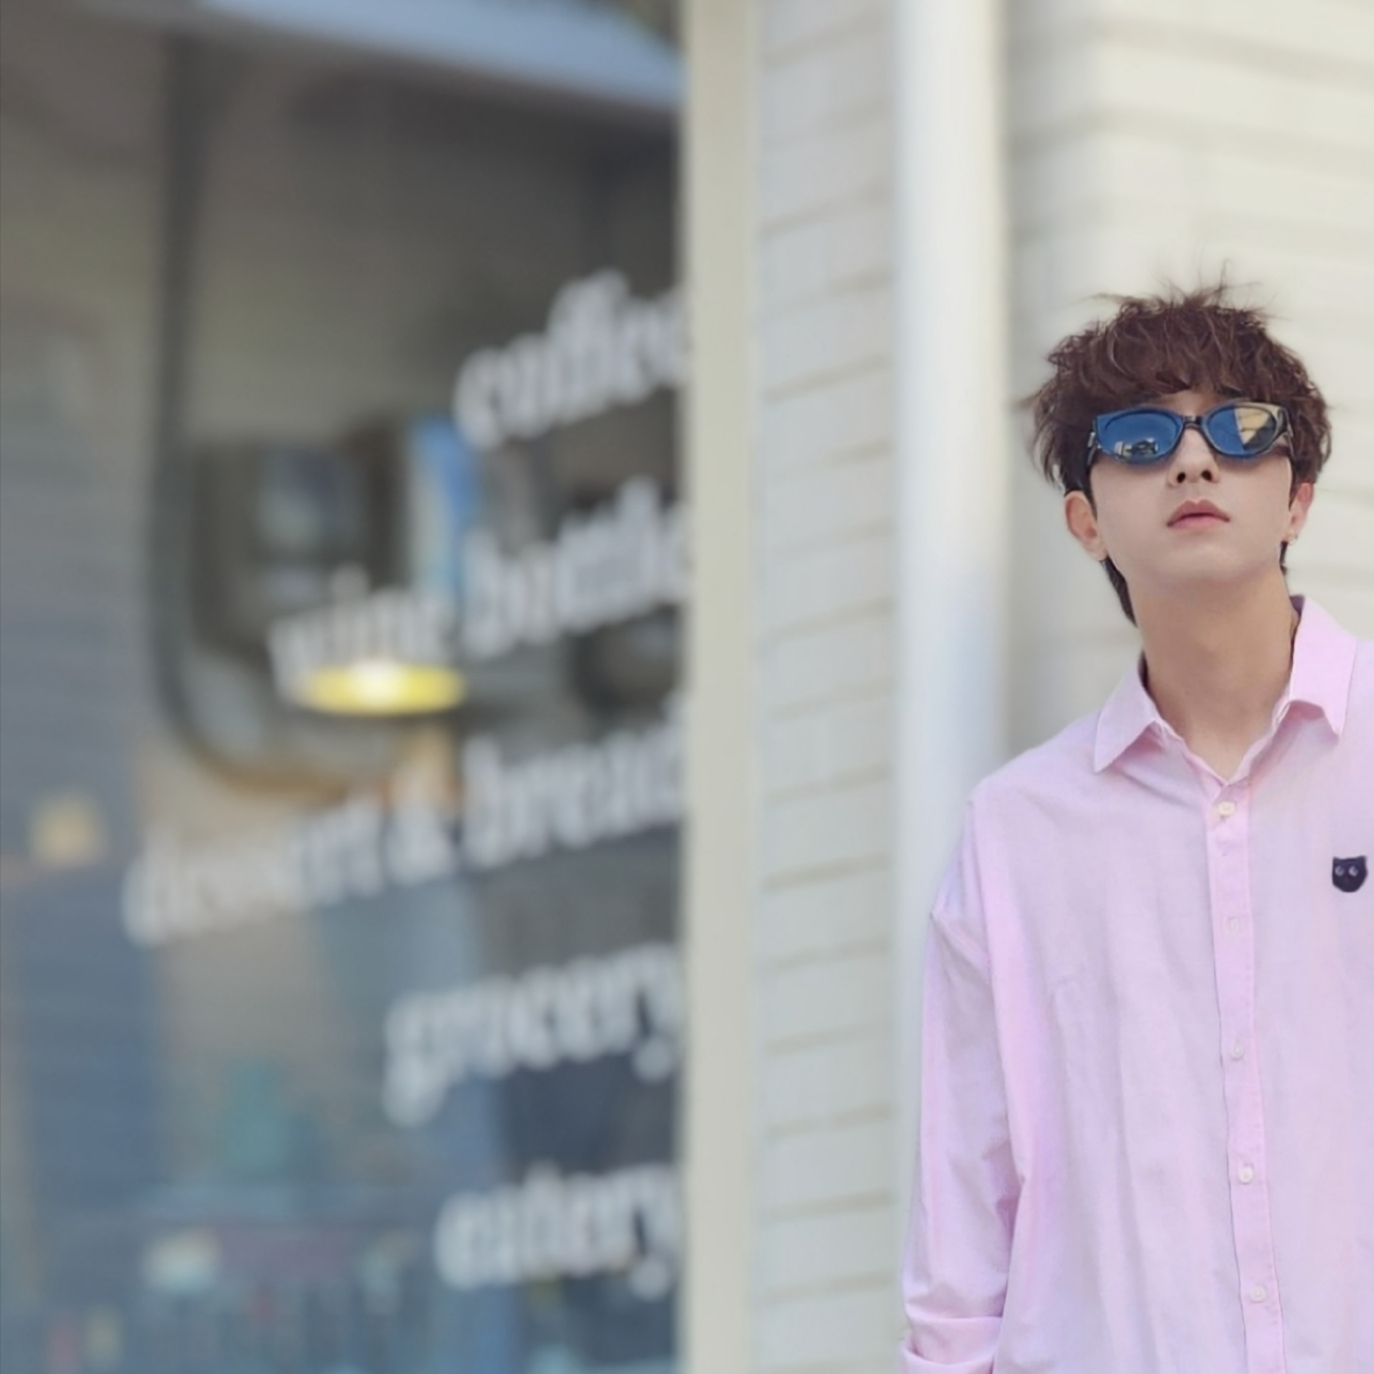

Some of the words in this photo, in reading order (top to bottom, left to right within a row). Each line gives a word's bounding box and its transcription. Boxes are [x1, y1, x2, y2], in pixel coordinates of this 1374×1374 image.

[124, 795, 384, 946] dessert
[386, 942, 684, 1124] grocery
[436, 1163, 684, 1299] eatery
